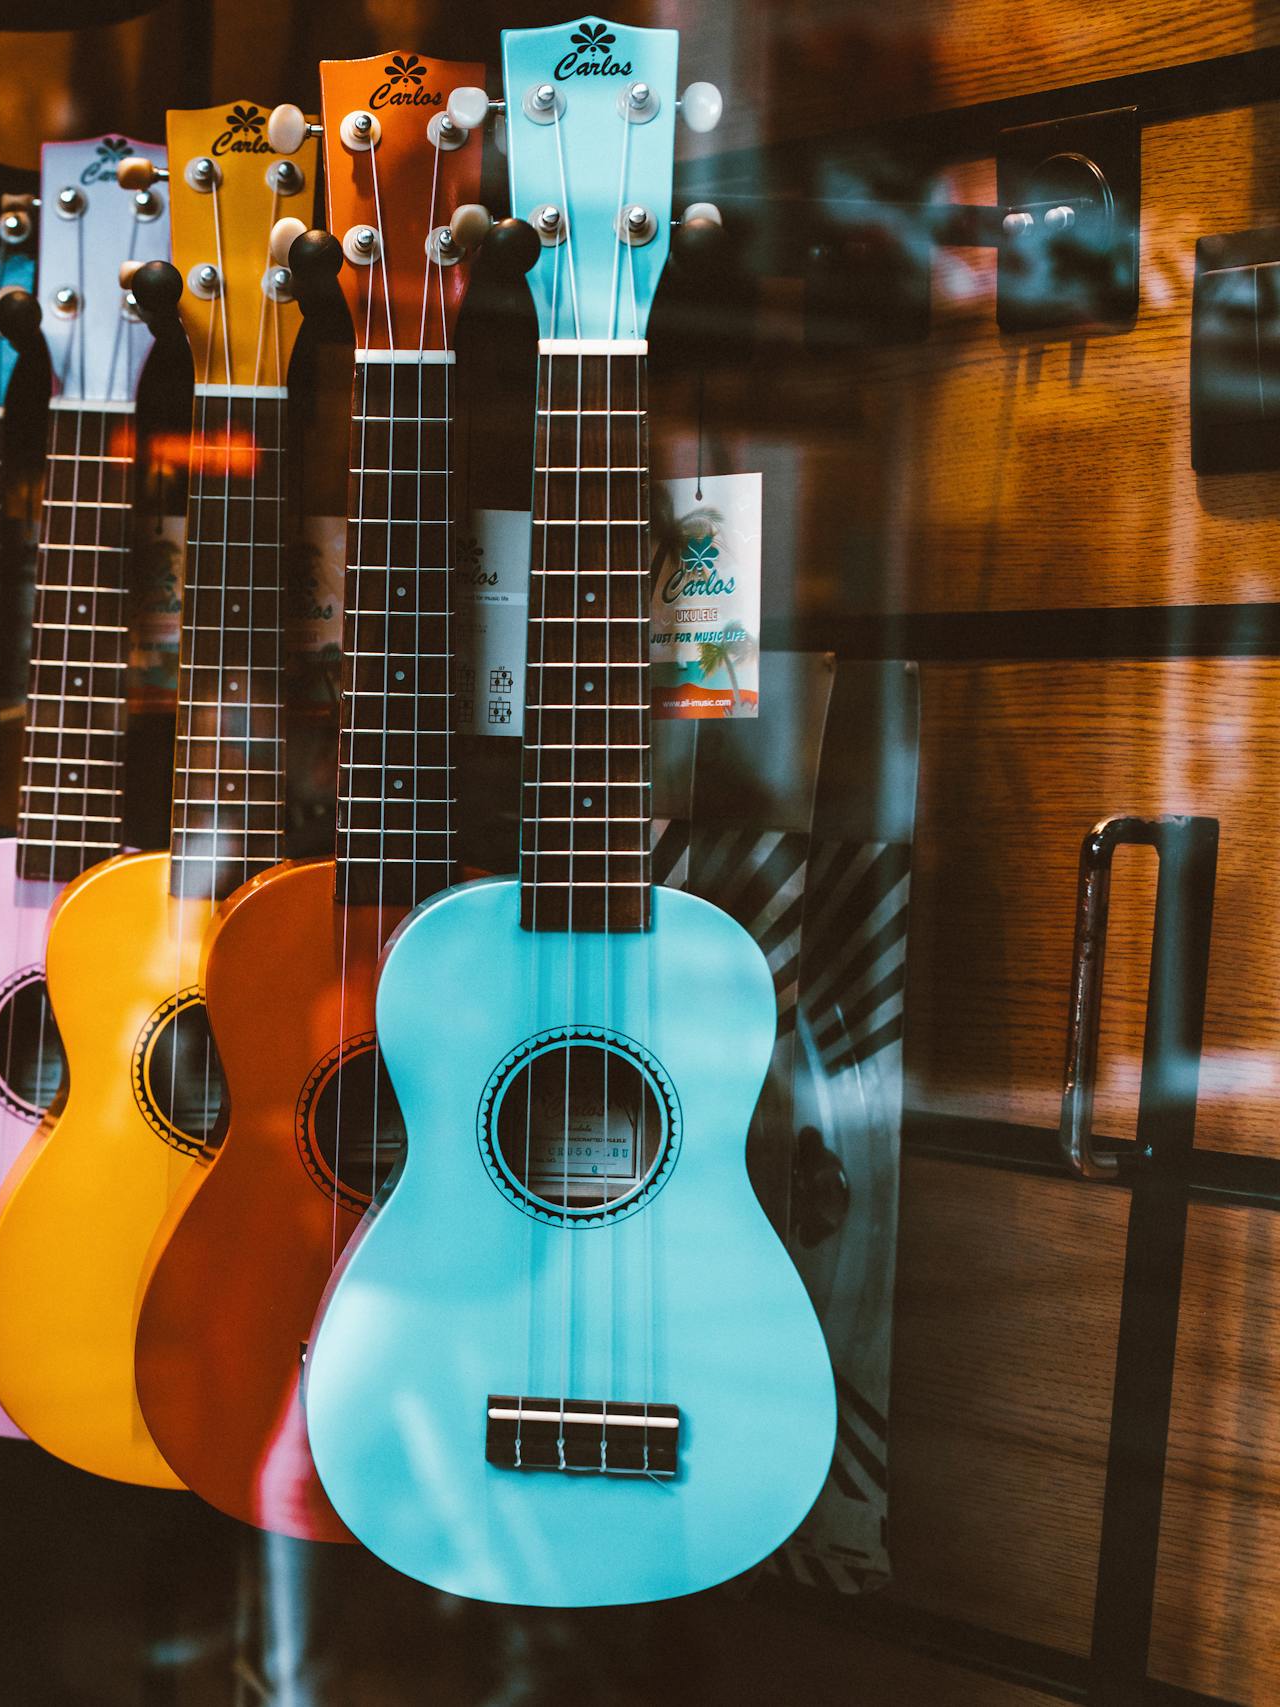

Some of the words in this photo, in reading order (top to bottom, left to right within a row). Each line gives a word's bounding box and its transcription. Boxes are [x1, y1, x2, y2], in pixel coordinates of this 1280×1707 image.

[554, 52, 632, 81] Carlos
[369, 83, 442, 110] Carlos
[211, 131, 277, 156] Carlo
[662, 568, 735, 604] Carlos
[675, 608, 718, 623] UKULELE
[651, 633, 672, 644] JUST
[674, 633, 692, 643] FOR
[694, 632, 723, 643] MUSIC
[726, 631, 748, 642] LIFE
